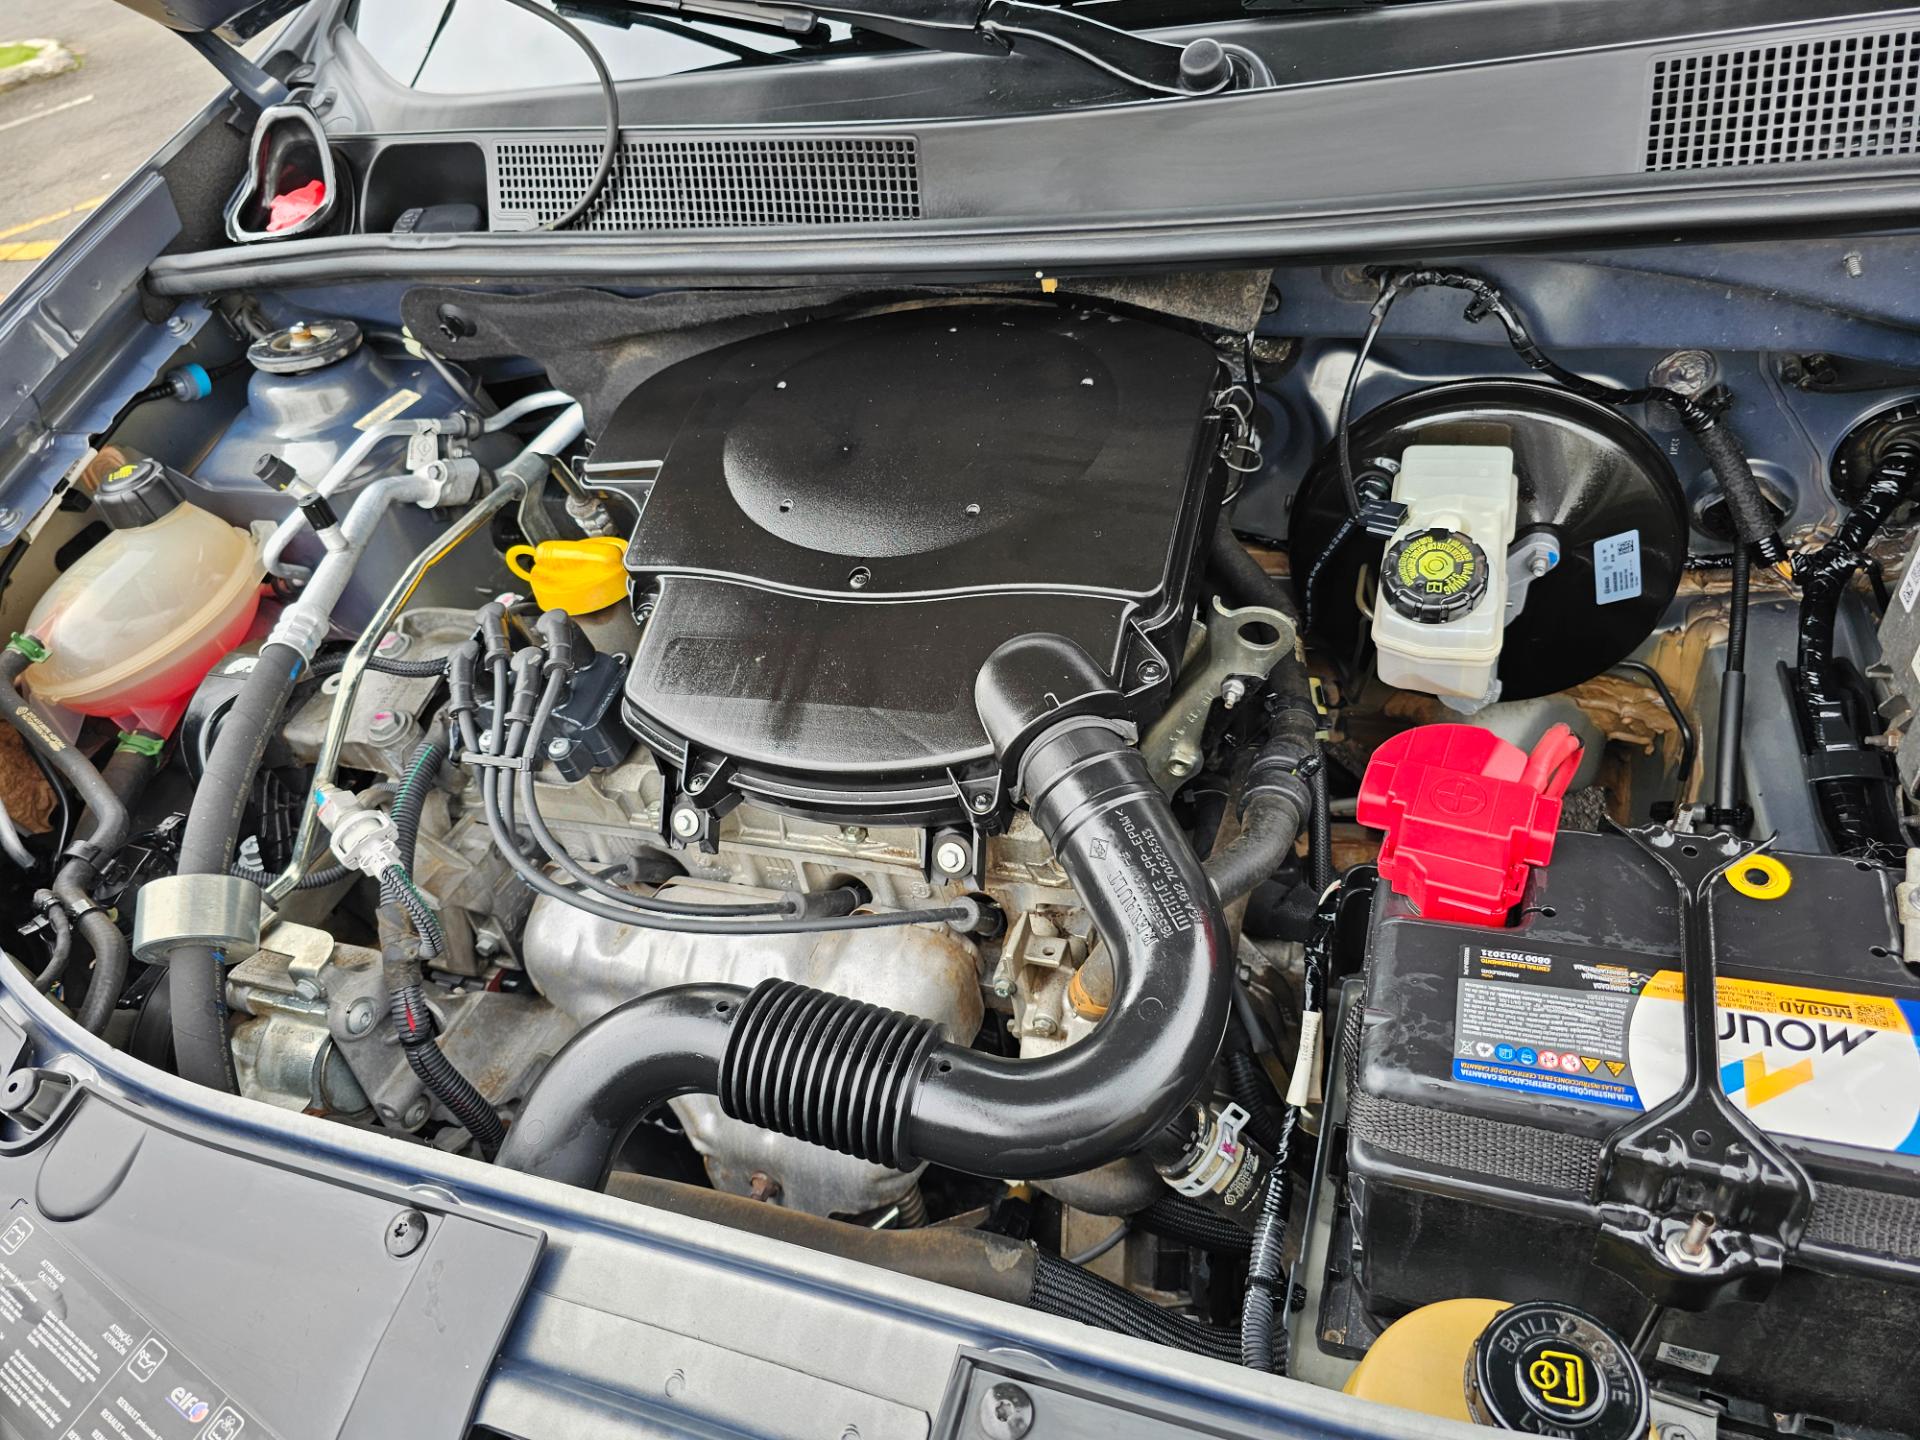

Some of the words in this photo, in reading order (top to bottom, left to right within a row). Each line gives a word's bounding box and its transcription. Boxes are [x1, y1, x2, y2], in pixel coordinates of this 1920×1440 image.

[1443, 562, 1473, 594] WARNING
[1107, 870, 1158, 946] RENAULT
[1481, 949, 1523, 961] 7012021
[1525, 954, 1551, 964] 0800
[1459, 1068, 1497, 1080] GARANTIA
[1508, 1076, 1556, 1090] CERTIFICADO
[109, 1323, 133, 1347] ATENÇÃO
[1500, 1317, 1567, 1353] BAILLY
[1591, 1340, 1629, 1404] COMTE
[116, 1396, 141, 1421] RENAULT
[170, 1386, 198, 1411] elf
[100, 1408, 125, 1433] RENAULT
